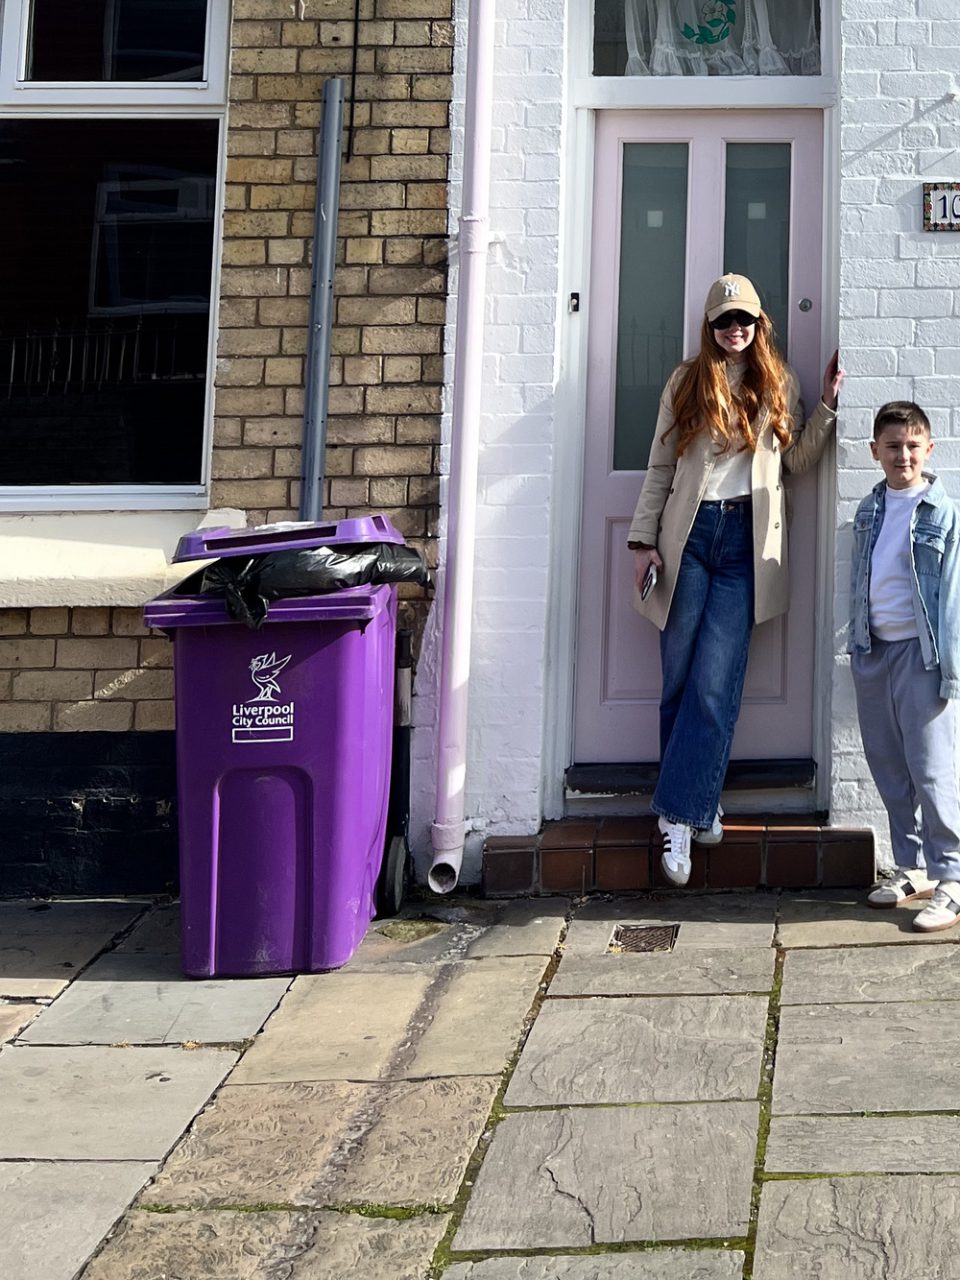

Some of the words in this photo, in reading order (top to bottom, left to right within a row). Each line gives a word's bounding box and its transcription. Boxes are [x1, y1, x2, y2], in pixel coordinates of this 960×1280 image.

[724, 281, 740, 297] NY
[232, 702, 294, 718] Liverpool
[232, 716, 253, 728] City
[255, 714, 294, 726] Council
